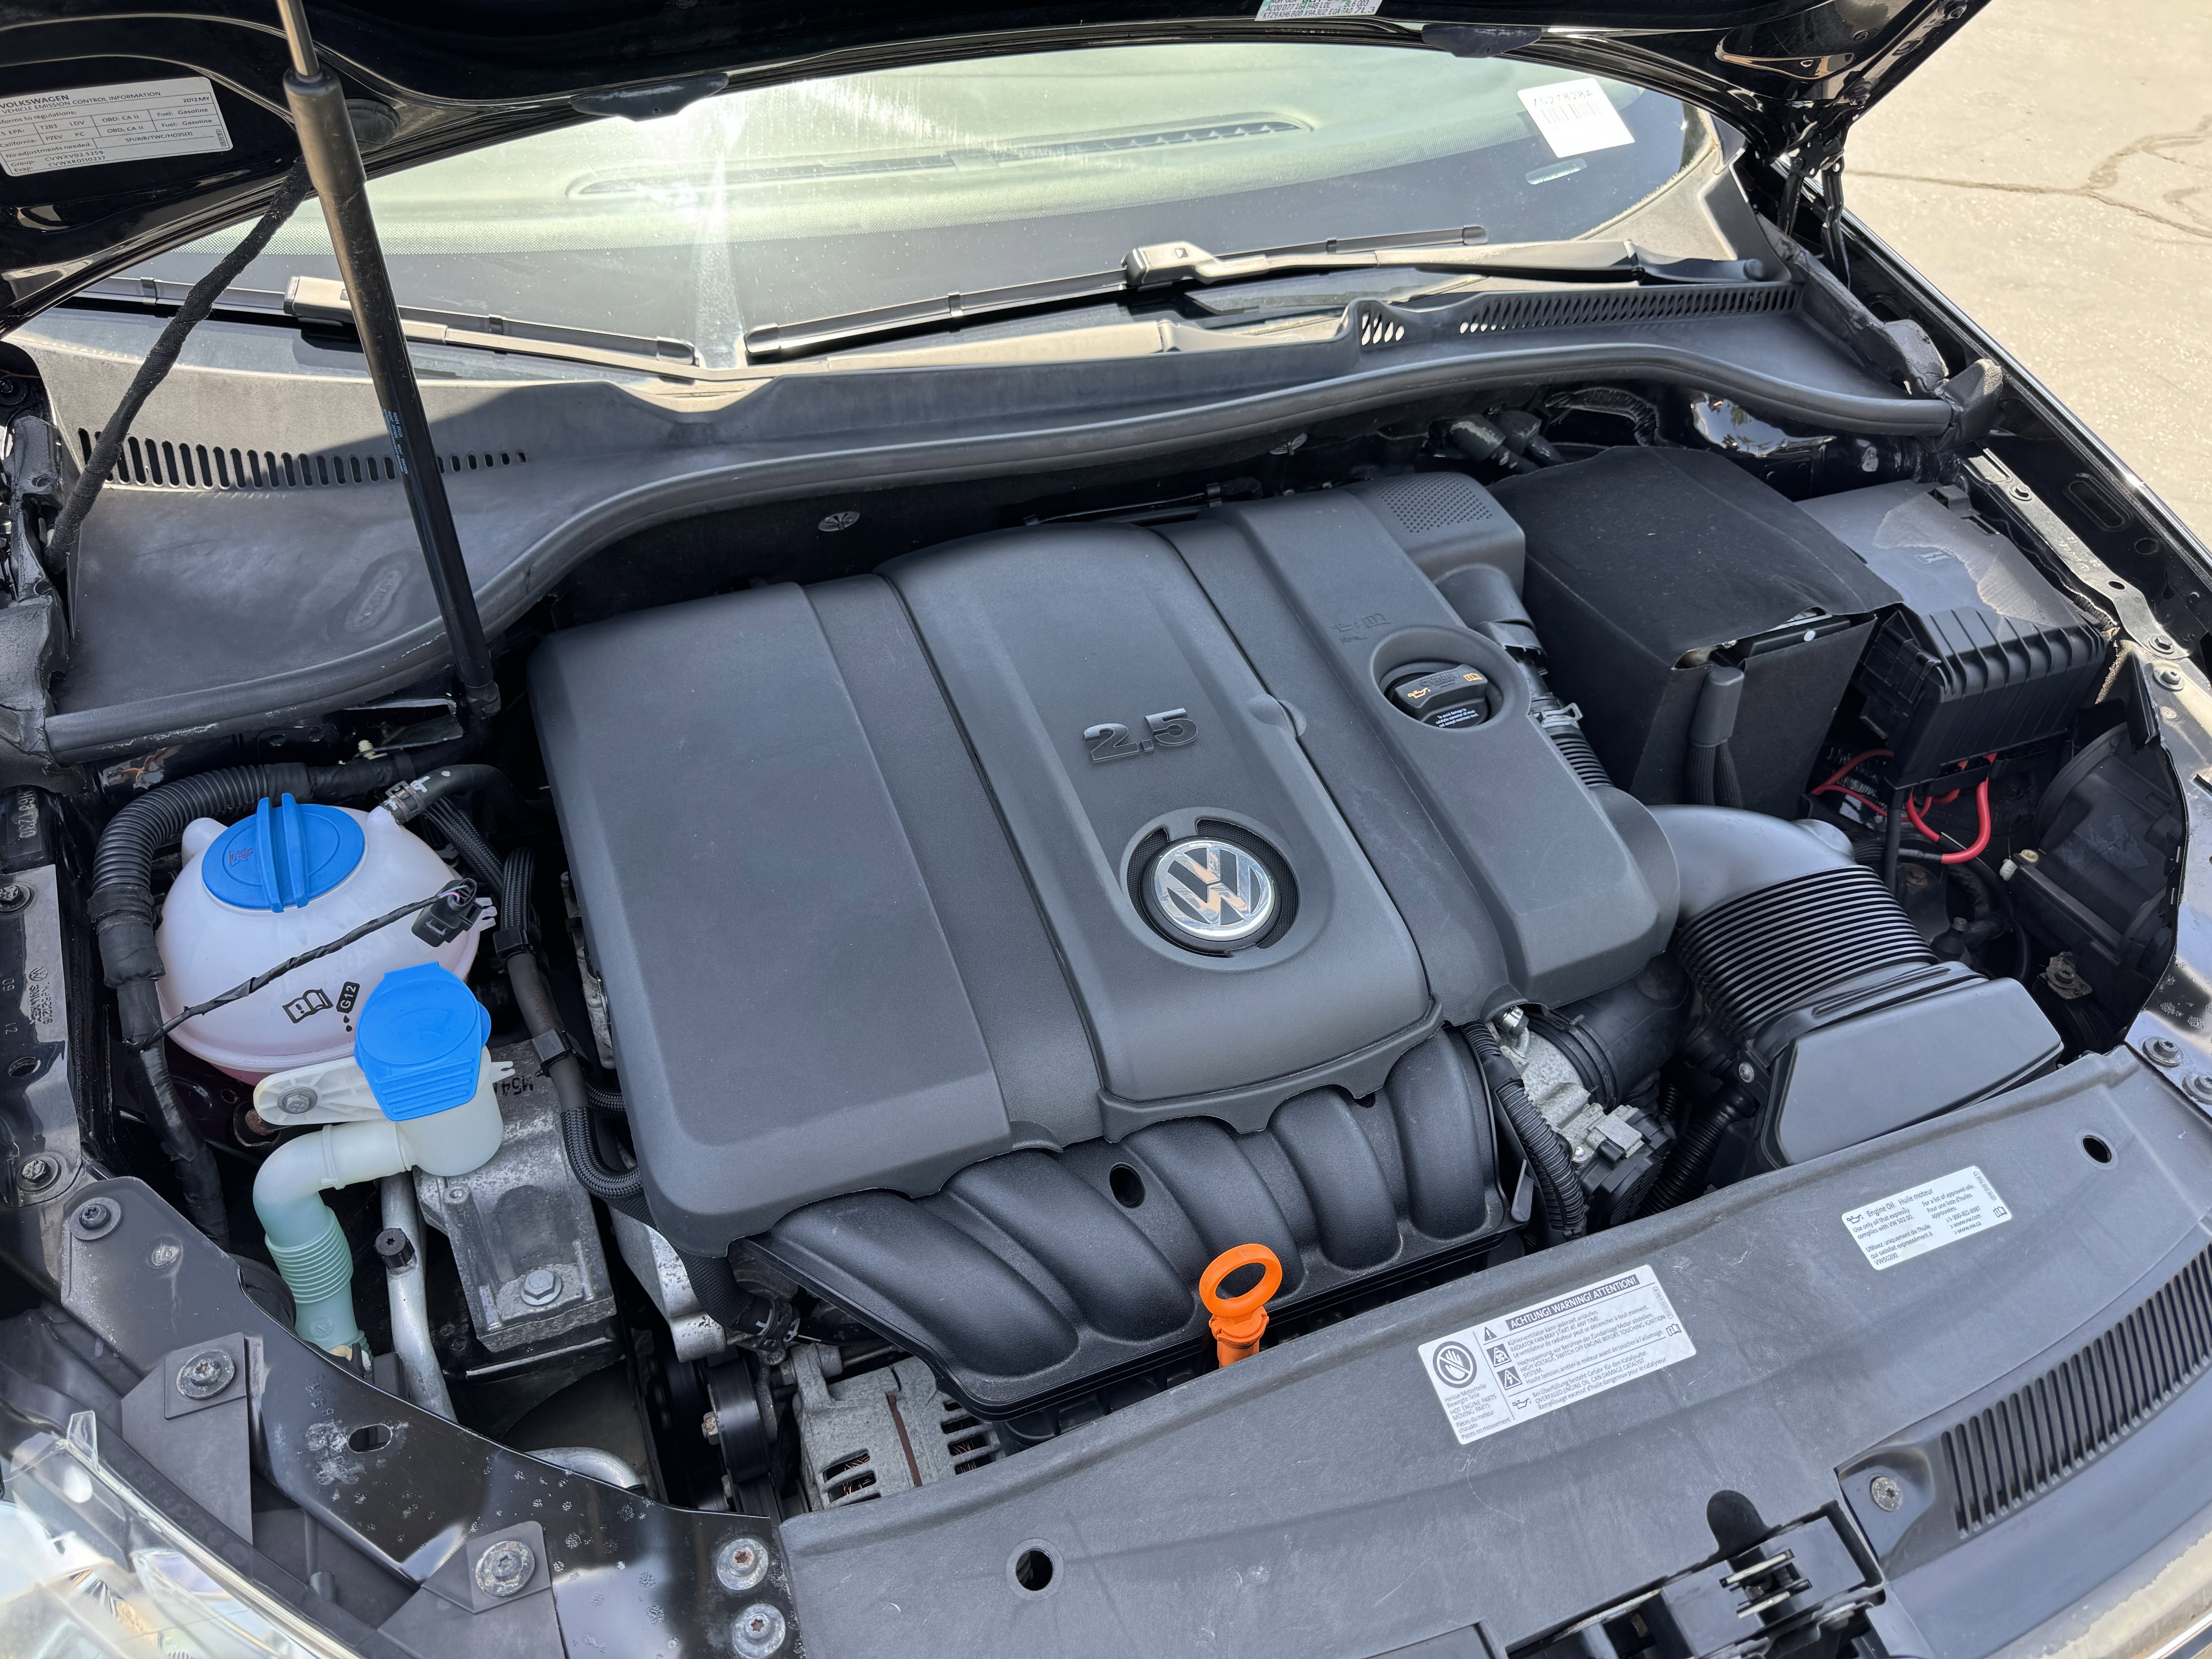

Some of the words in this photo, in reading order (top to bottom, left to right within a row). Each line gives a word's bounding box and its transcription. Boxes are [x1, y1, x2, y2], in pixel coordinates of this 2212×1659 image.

[0, 95, 69, 108] VOLKSWAGEN
[2, 106, 33, 114] VEHICLE
[35, 101, 70, 109] EMISSION
[109, 91, 161, 101] INFORMATION
[18, 146, 62, 156] adjustments
[1082, 708, 1199, 763] 2.5
[340, 985, 357, 1009] G12
[1946, 1186, 1966, 1198] approved
[1866, 1206, 1887, 1217] Engine
[1898, 1195, 1914, 1205] Huile
[1913, 1188, 1933, 1199] moteur
[1953, 1214, 1981, 1227] www.vw.com
[1956, 1221, 1982, 1233] www.vw.ca
[1857, 1228, 1878, 1239] complies
[1884, 1231, 1911, 1245] uniquement
[1878, 1245, 1897, 1255] satisfait
[1511, 1307, 1552, 1328] ACHTUNG!
[1551, 1292, 1592, 1312] WARNING!
[1593, 1276, 1637, 1298] ATTENTION!
[1616, 1321, 1631, 1329] Motor
[1510, 1340, 1534, 1352] RADIATOR
[1544, 1331, 1555, 1340] MAY
[1555, 1326, 1569, 1336] START
[1518, 1343, 1544, 1355] ventilateur
[1551, 1333, 1572, 1344] radiateur
[1572, 1328, 1584, 1337] peut
[1520, 1364, 1534, 1372] HIGH
[1555, 1349, 1575, 1359] SWITCH
[1583, 1338, 1602, 1348] ENGINE
[1601, 1331, 1620, 1342] BEFORE
[1619, 1322, 1645, 1335] TOUCHING
[1644, 1314, 1666, 1326] IGNITION
[1525, 1376, 1541, 1384] Haute
[1581, 1354, 1598, 1363] moteur
[1598, 1348, 1611, 1357] avant
[1617, 1340, 1635, 1350] toucher
[1568, 1373, 1587, 1384] besteht
[1587, 1367, 1603, 1376] Gefahr
[1444, 1393, 1461, 1402] Heisse
[1460, 1384, 1486, 1396] Motorteile
[1535, 1389, 1563, 1403] OVERFILLED
[1563, 1382, 1582, 1393] ENGINE
[1601, 1366, 1623, 1378] DAMAGE
[1537, 1395, 1568, 1410] Remplissage
[1568, 1386, 1586, 1398] excessif
[1627, 1368, 1638, 1376] pour
[1446, 1397, 1468, 1408] Bewegte
[1449, 1407, 1461, 1415] HOT
[1461, 1399, 1481, 1411] ENGINE
[1481, 1393, 1496, 1403] PARTS
[1452, 1408, 1474, 1420] MOVING
[1474, 1402, 1490, 1412] PARTS
[1477, 1410, 1494, 1419] moteur
[1458, 1423, 1478, 1433] chaudes
[1482, 1417, 1511, 1431] mouvement
